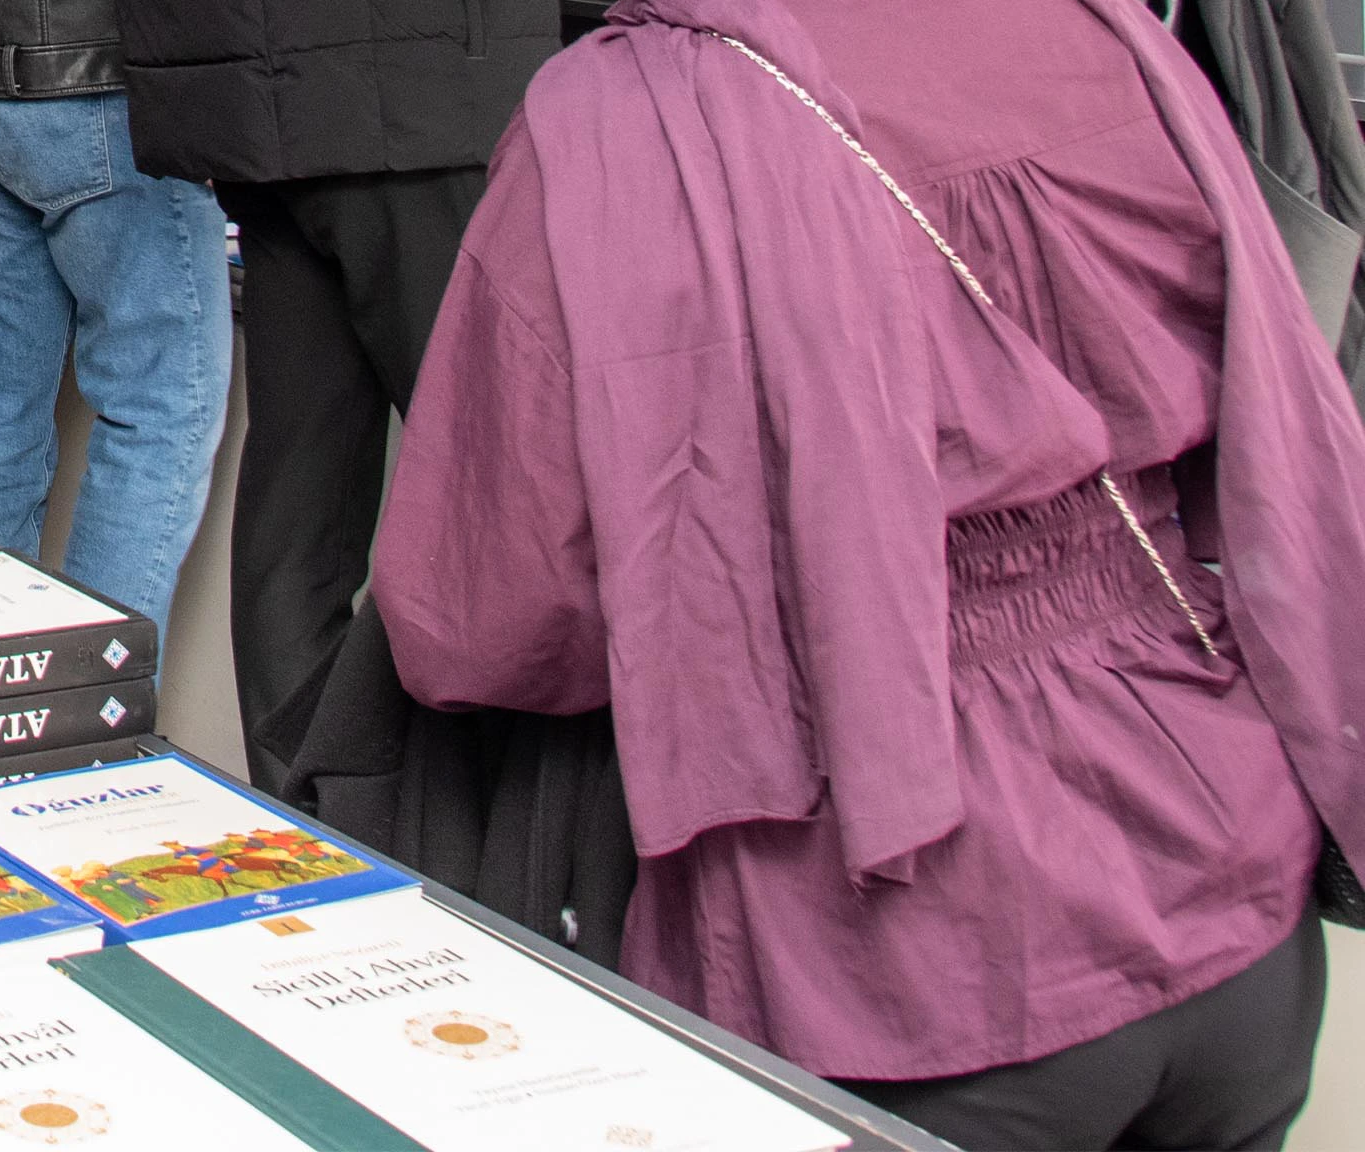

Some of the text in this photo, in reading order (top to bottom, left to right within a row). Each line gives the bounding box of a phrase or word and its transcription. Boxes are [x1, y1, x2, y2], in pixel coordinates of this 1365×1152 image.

[11, 785, 164, 817] Oğuzlar
[370, 948, 467, 978] Ahvâl
[303, 968, 473, 1011] Defterleri
